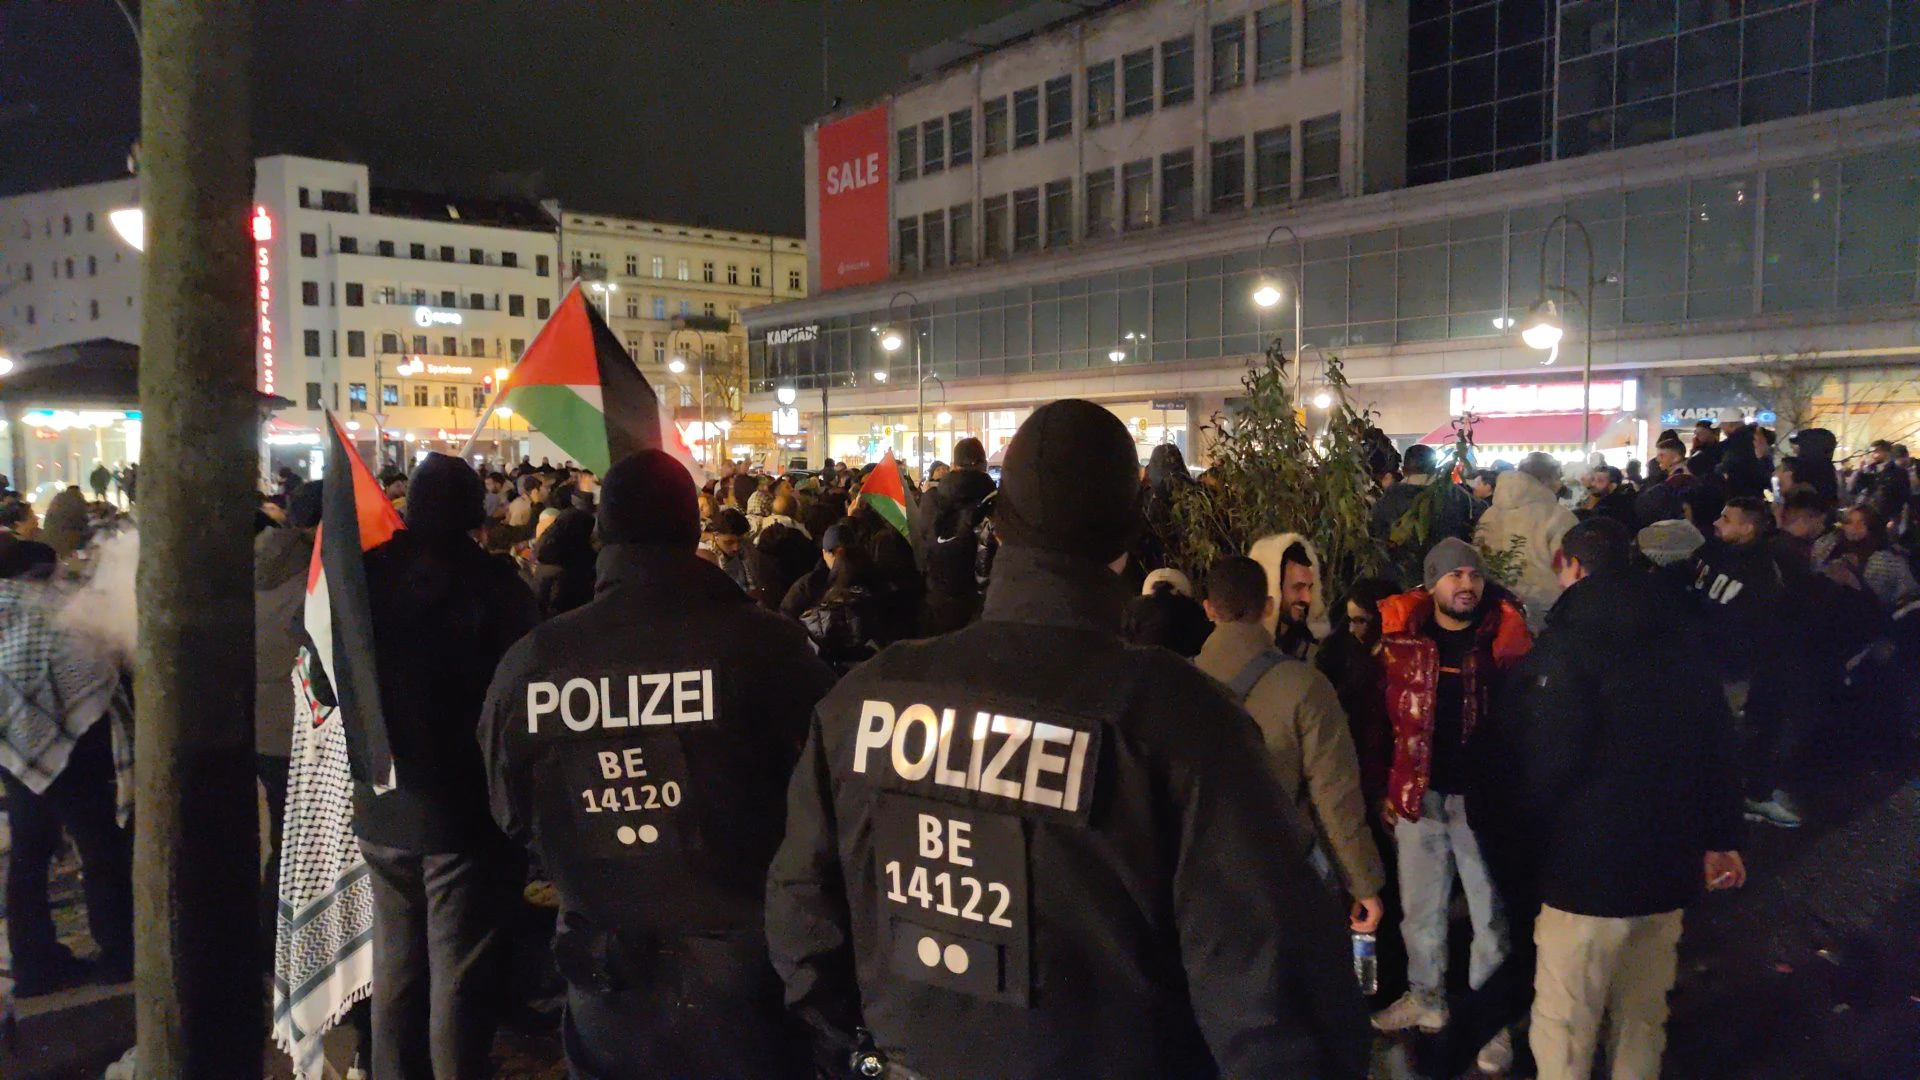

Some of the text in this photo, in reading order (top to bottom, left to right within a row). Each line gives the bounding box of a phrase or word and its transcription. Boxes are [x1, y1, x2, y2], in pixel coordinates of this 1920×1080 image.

[827, 152, 879, 195] SALE
[258, 247, 275, 395] Sparkasse
[767, 325, 819, 346] KARSTADT
[527, 669, 714, 734] POLIZEI
[597, 748, 647, 780] BE
[853, 700, 1091, 812] POLIZEI
[582, 781, 682, 813] 14120
[918, 813, 973, 867] BE
[885, 861, 1013, 928] 14122
